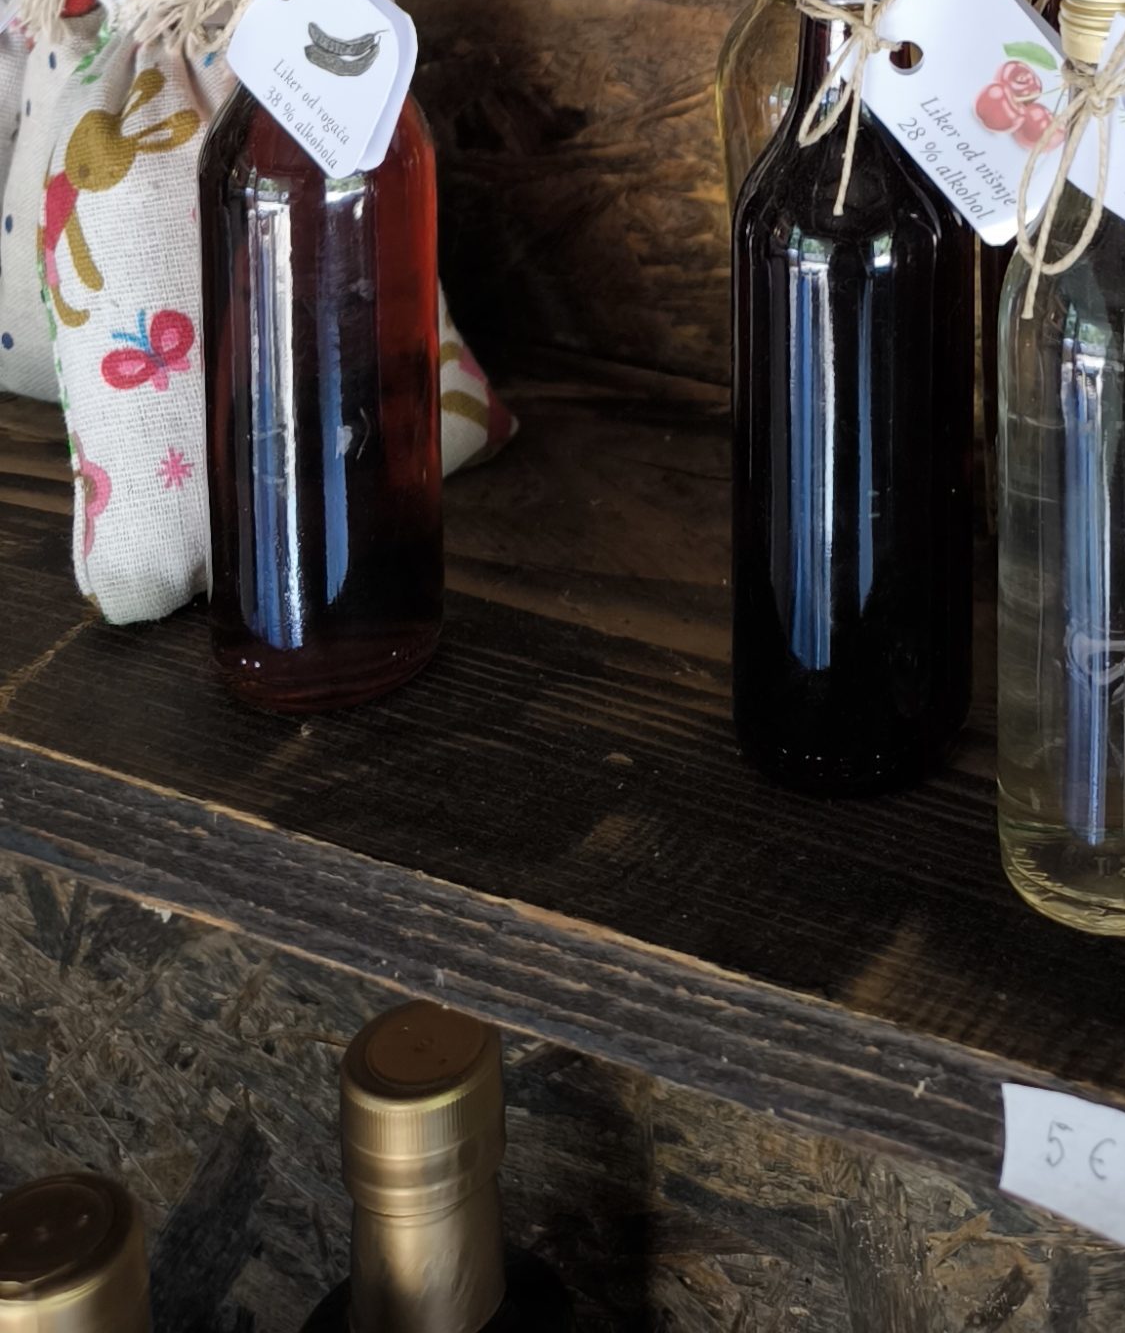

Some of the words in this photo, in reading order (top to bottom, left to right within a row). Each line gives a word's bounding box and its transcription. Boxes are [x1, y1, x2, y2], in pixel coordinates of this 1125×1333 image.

[273, 59, 302, 92] Liker
[302, 93, 320, 109] od
[294, 122, 338, 169] alkohola
[897, 117, 926, 141] 28
[936, 165, 995, 220] alkohol
[920, 97, 960, 138] Liker
[957, 142, 986, 161] od
[975, 163, 1017, 206] višnje
